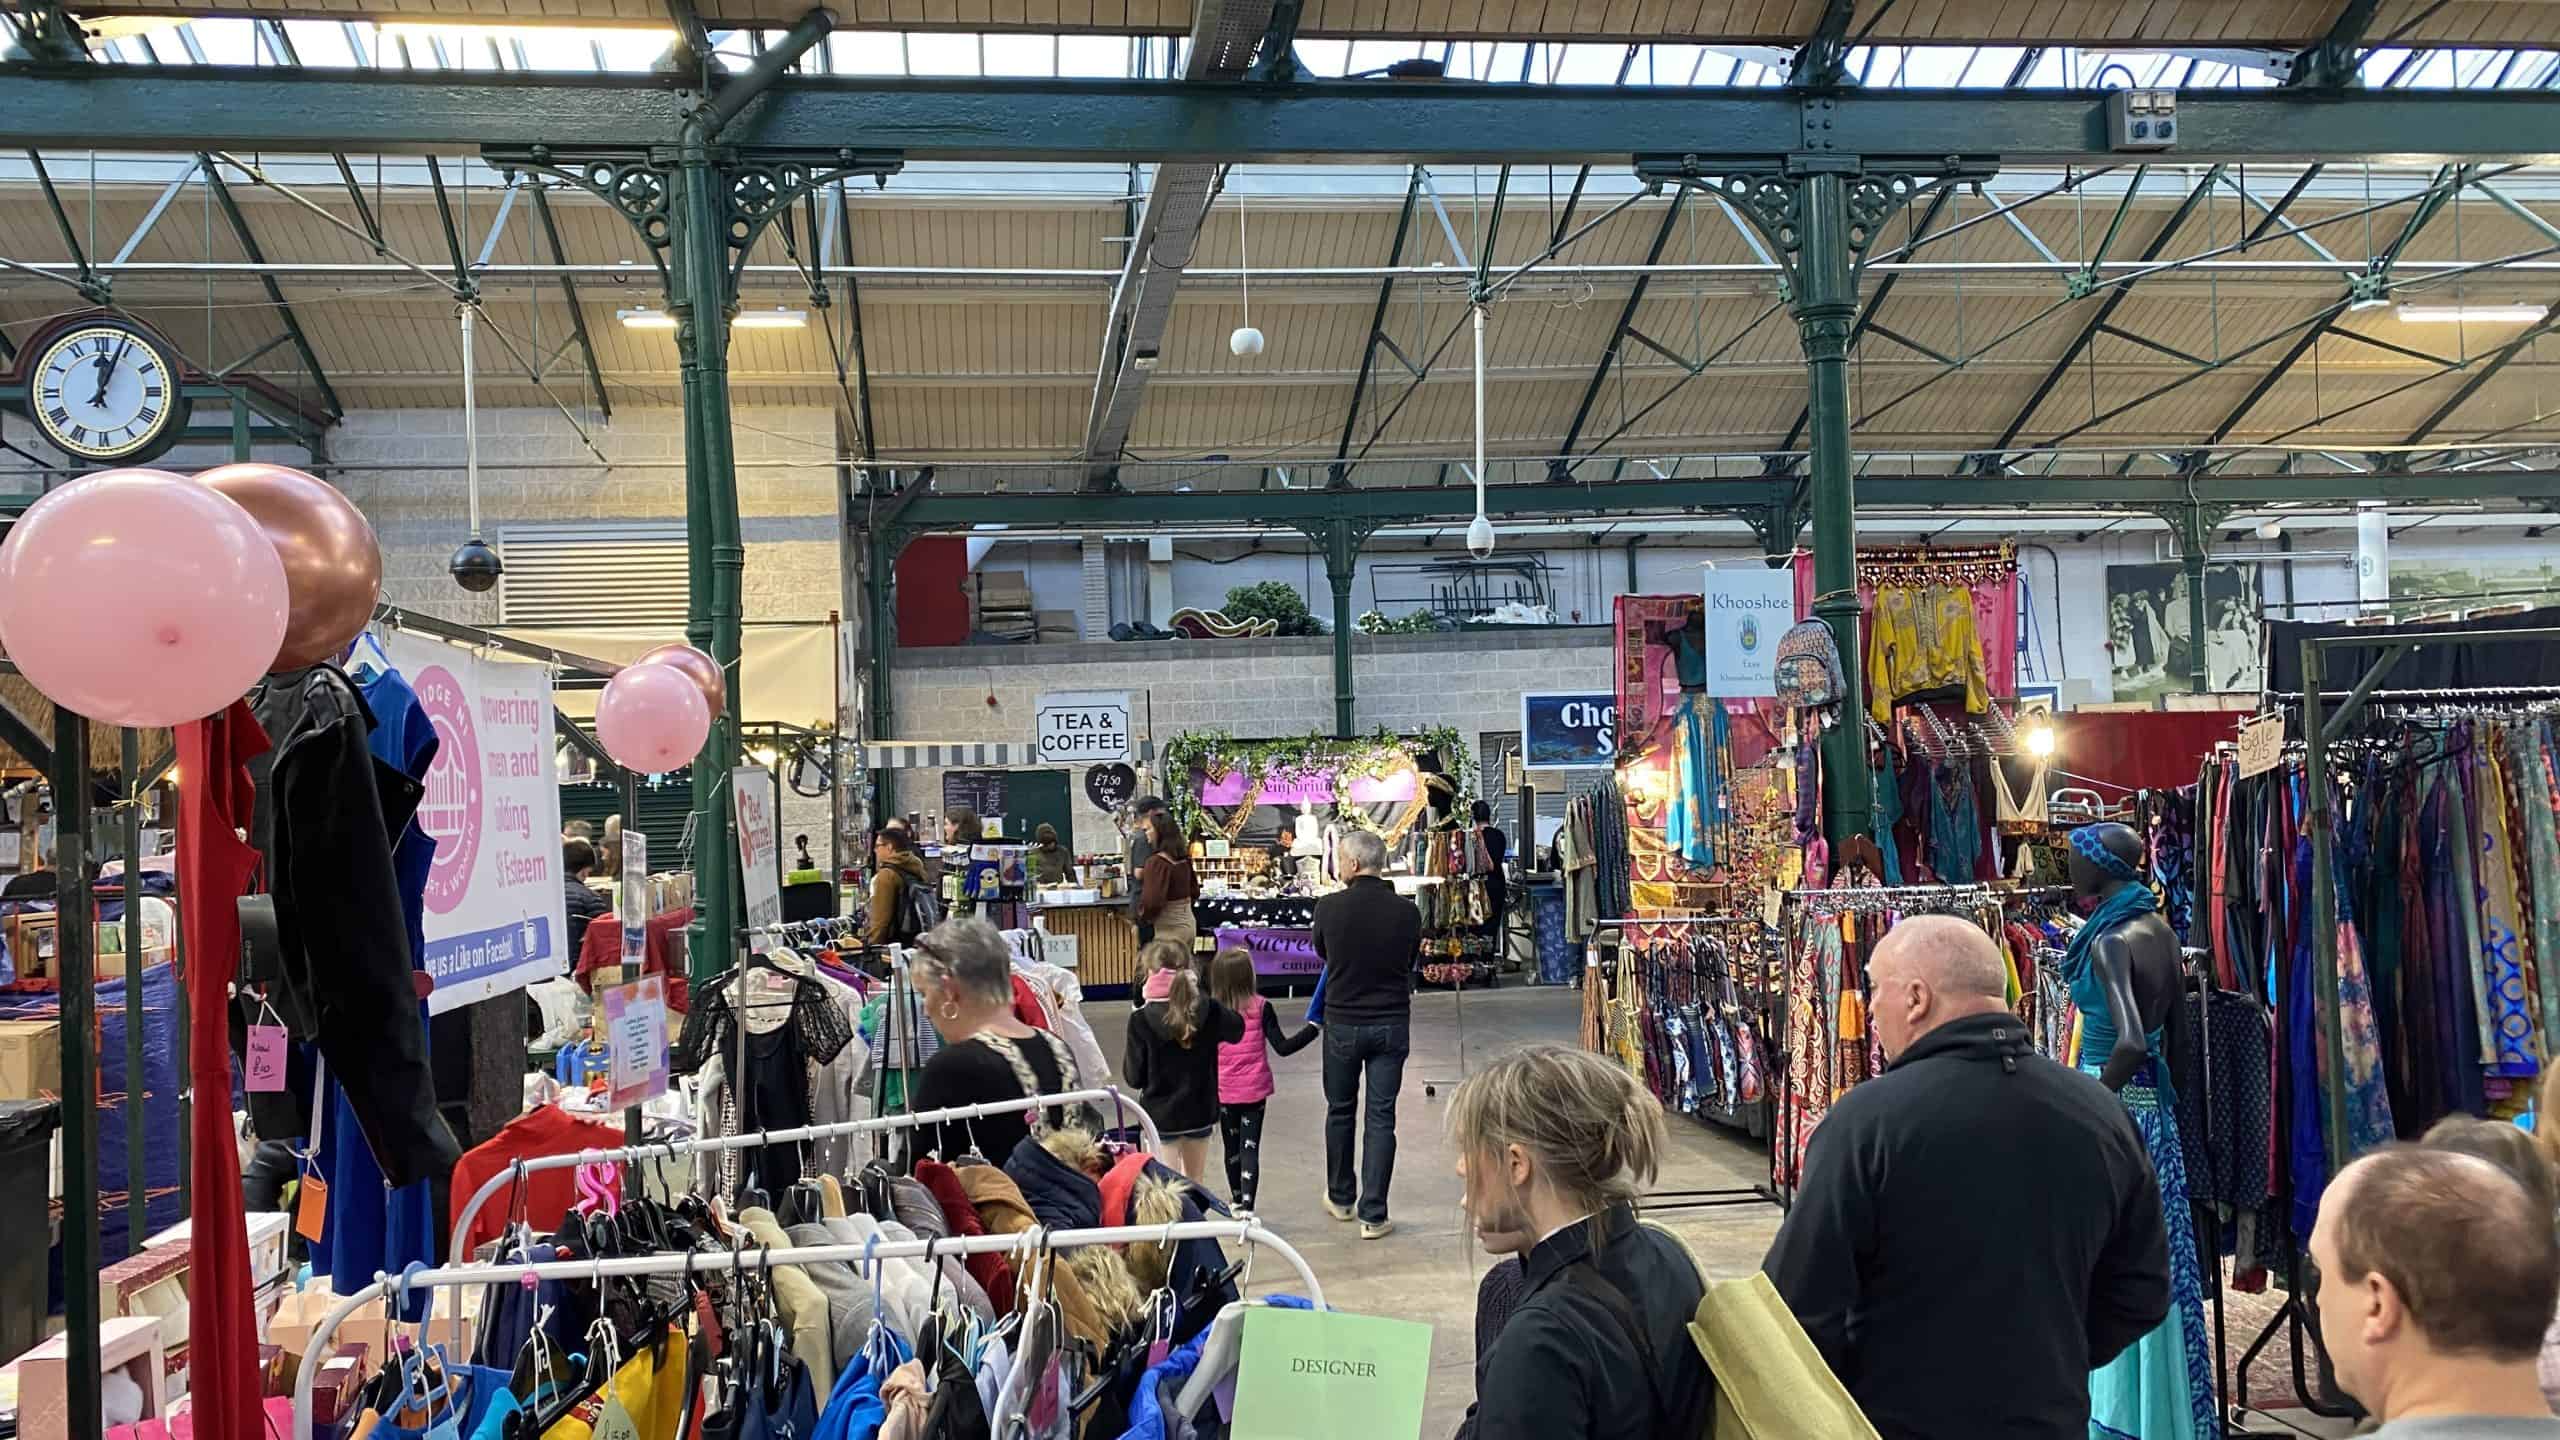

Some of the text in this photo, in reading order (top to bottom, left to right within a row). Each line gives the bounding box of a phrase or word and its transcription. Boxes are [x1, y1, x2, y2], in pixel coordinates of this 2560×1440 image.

[1712, 592, 1789, 609] Khooshee
[1051, 712, 1113, 730] TEA &
[1042, 733, 1125, 751] COFFEE
[2241, 725, 2275, 751] Sale
[511, 744, 539, 777] and
[1292, 1357, 1376, 1378] DESIGNER
